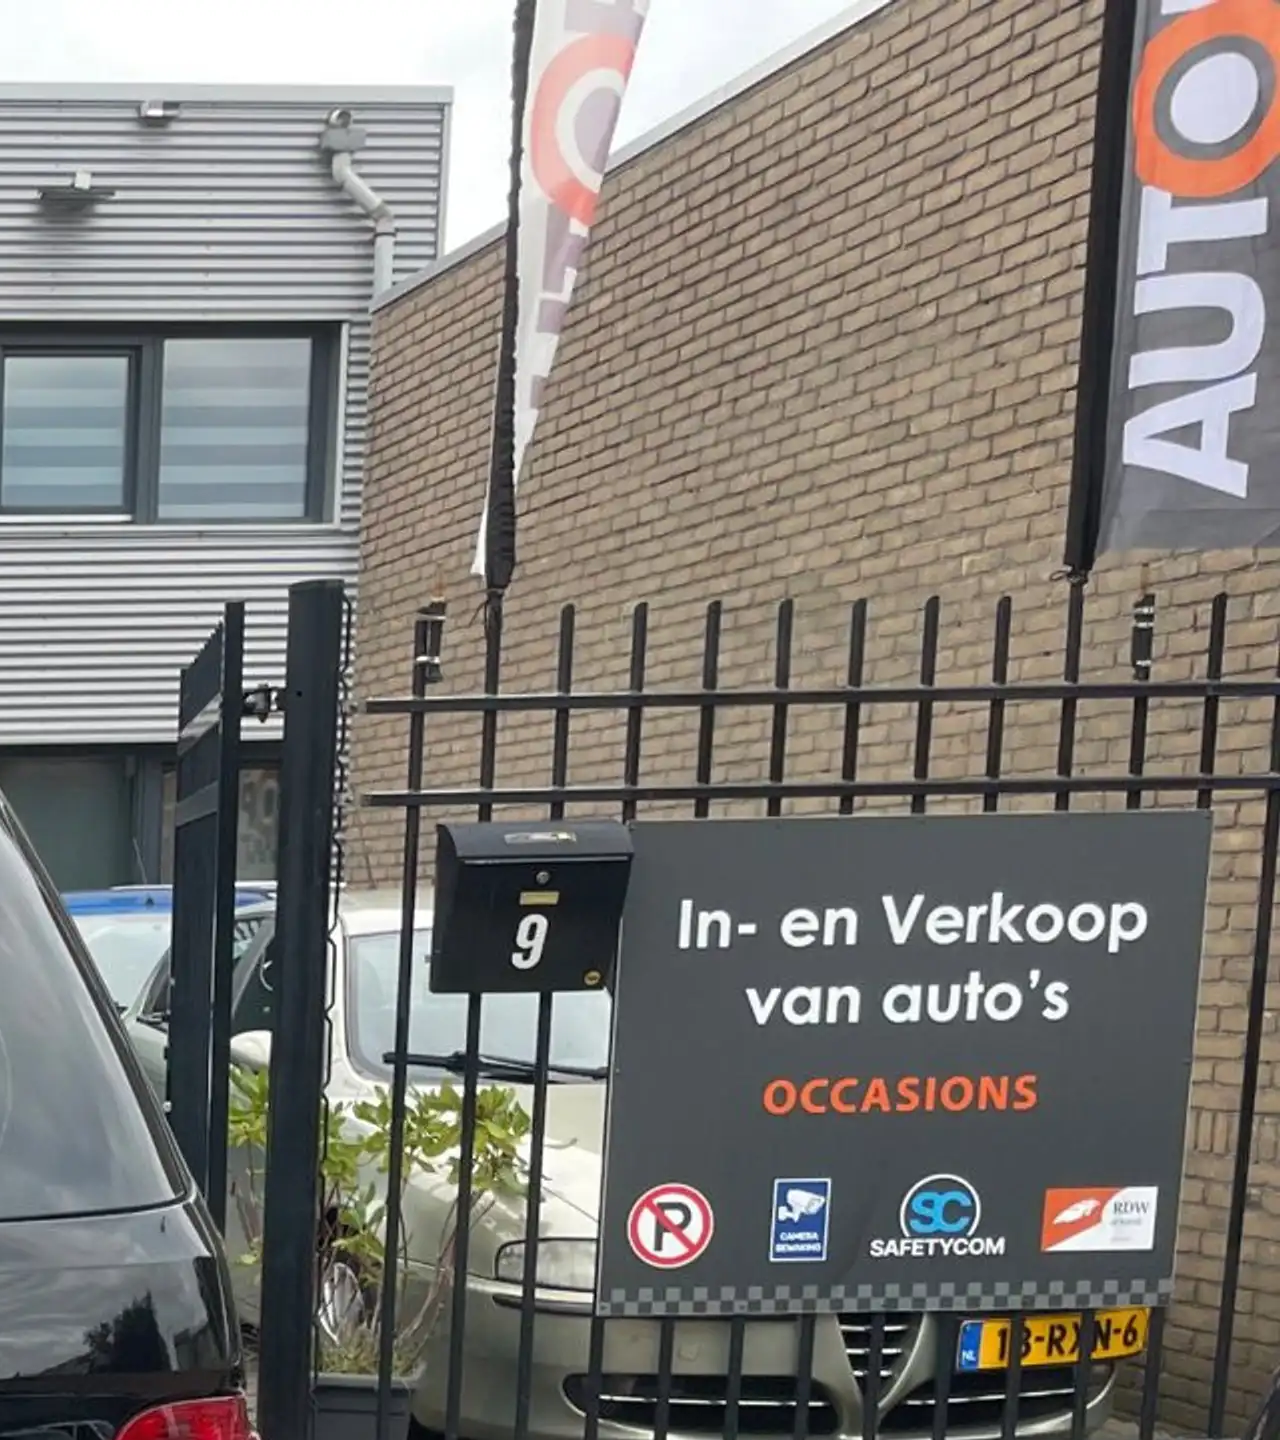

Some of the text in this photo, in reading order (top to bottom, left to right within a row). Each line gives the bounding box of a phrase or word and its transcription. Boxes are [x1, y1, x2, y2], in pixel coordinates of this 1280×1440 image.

[511, 913, 549, 970] 9
[678, 891, 1148, 953] In- en Verkoop
[745, 969, 1070, 1025] van auto's
[762, 1073, 1038, 1116] OCCASIONS
[909, 1190, 972, 1234] SC
[1113, 1201, 1149, 1214] RDW
[869, 1236, 1006, 1257] SAFETYCOM
